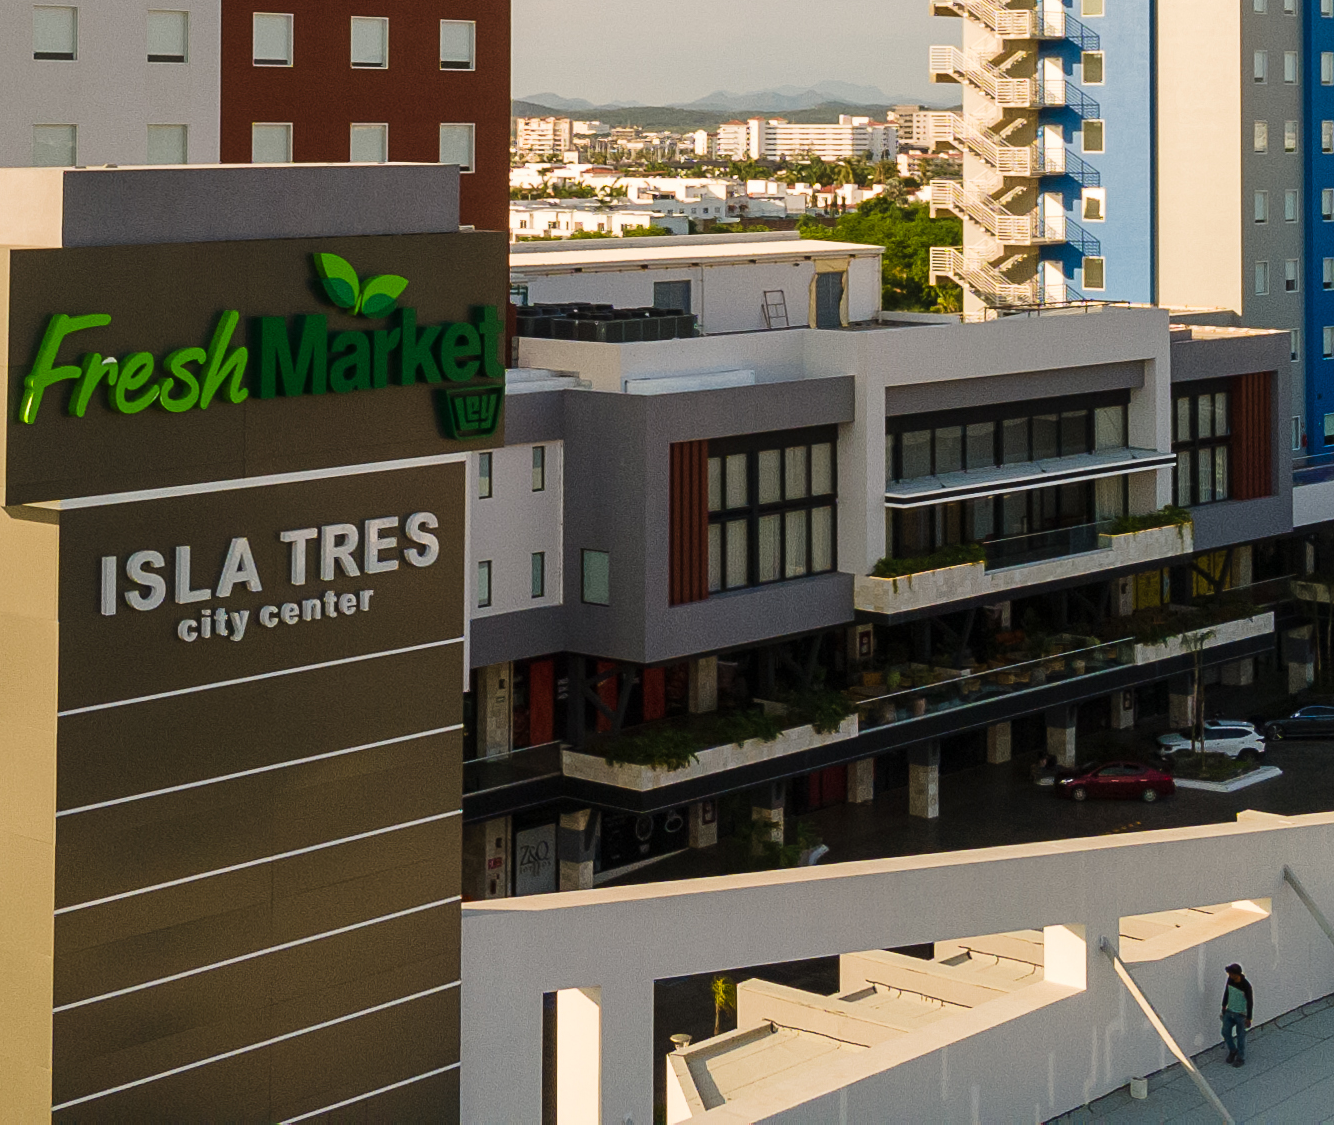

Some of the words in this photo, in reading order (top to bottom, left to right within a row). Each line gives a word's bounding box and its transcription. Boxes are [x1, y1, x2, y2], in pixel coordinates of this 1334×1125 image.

[18, 309, 249, 425] Fresh
[250, 305, 505, 399] Market
[101, 537, 263, 616] ISLA
[280, 511, 440, 587] TRES
[177, 605, 250, 642] city
[259, 585, 374, 629] center
